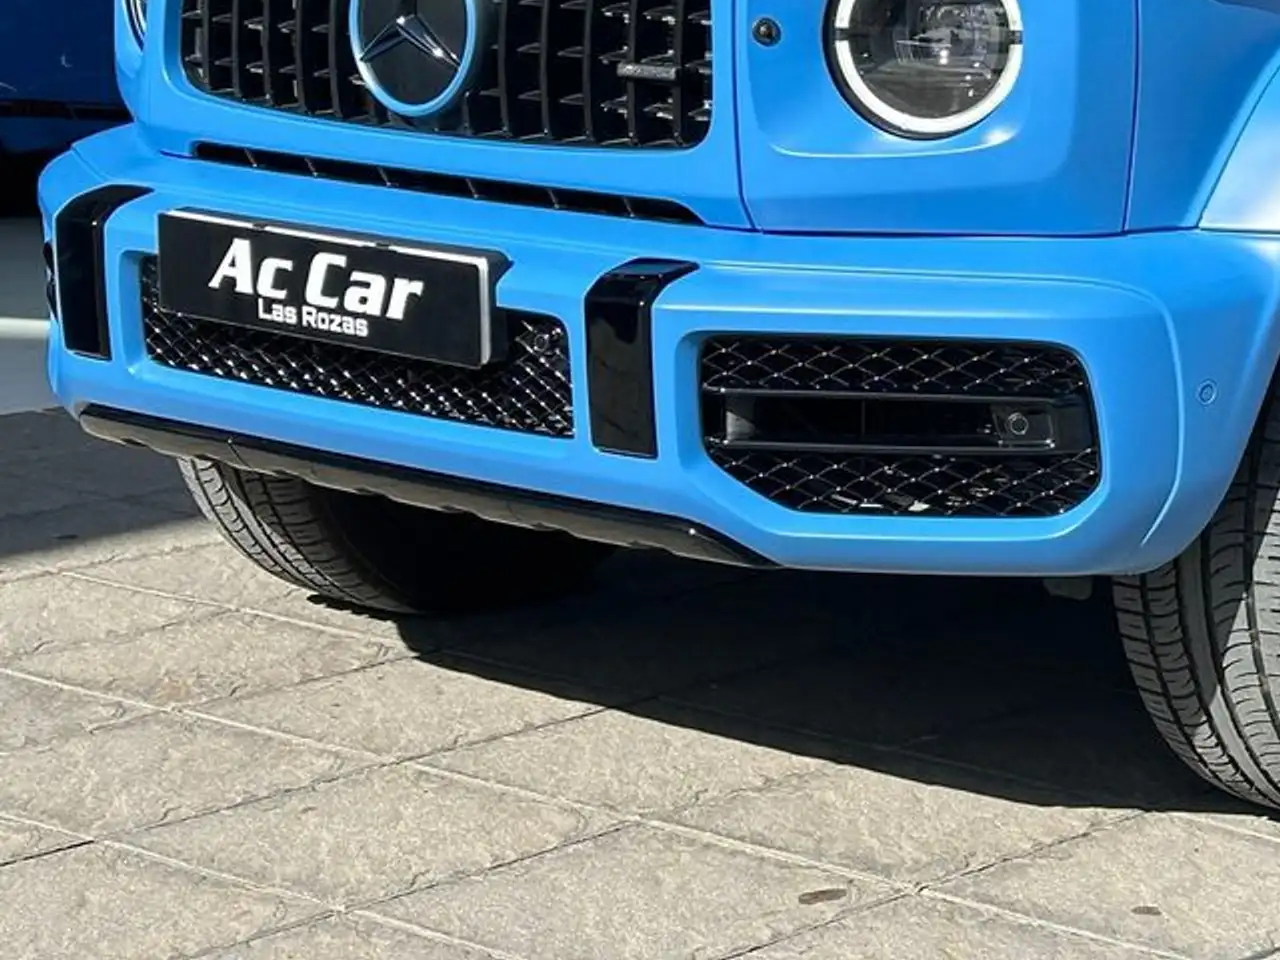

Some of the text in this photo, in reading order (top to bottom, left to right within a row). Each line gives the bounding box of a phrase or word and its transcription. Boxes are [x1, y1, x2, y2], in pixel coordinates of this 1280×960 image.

[209, 237, 424, 320] Ac Car
[258, 297, 369, 337] Las Rozas
